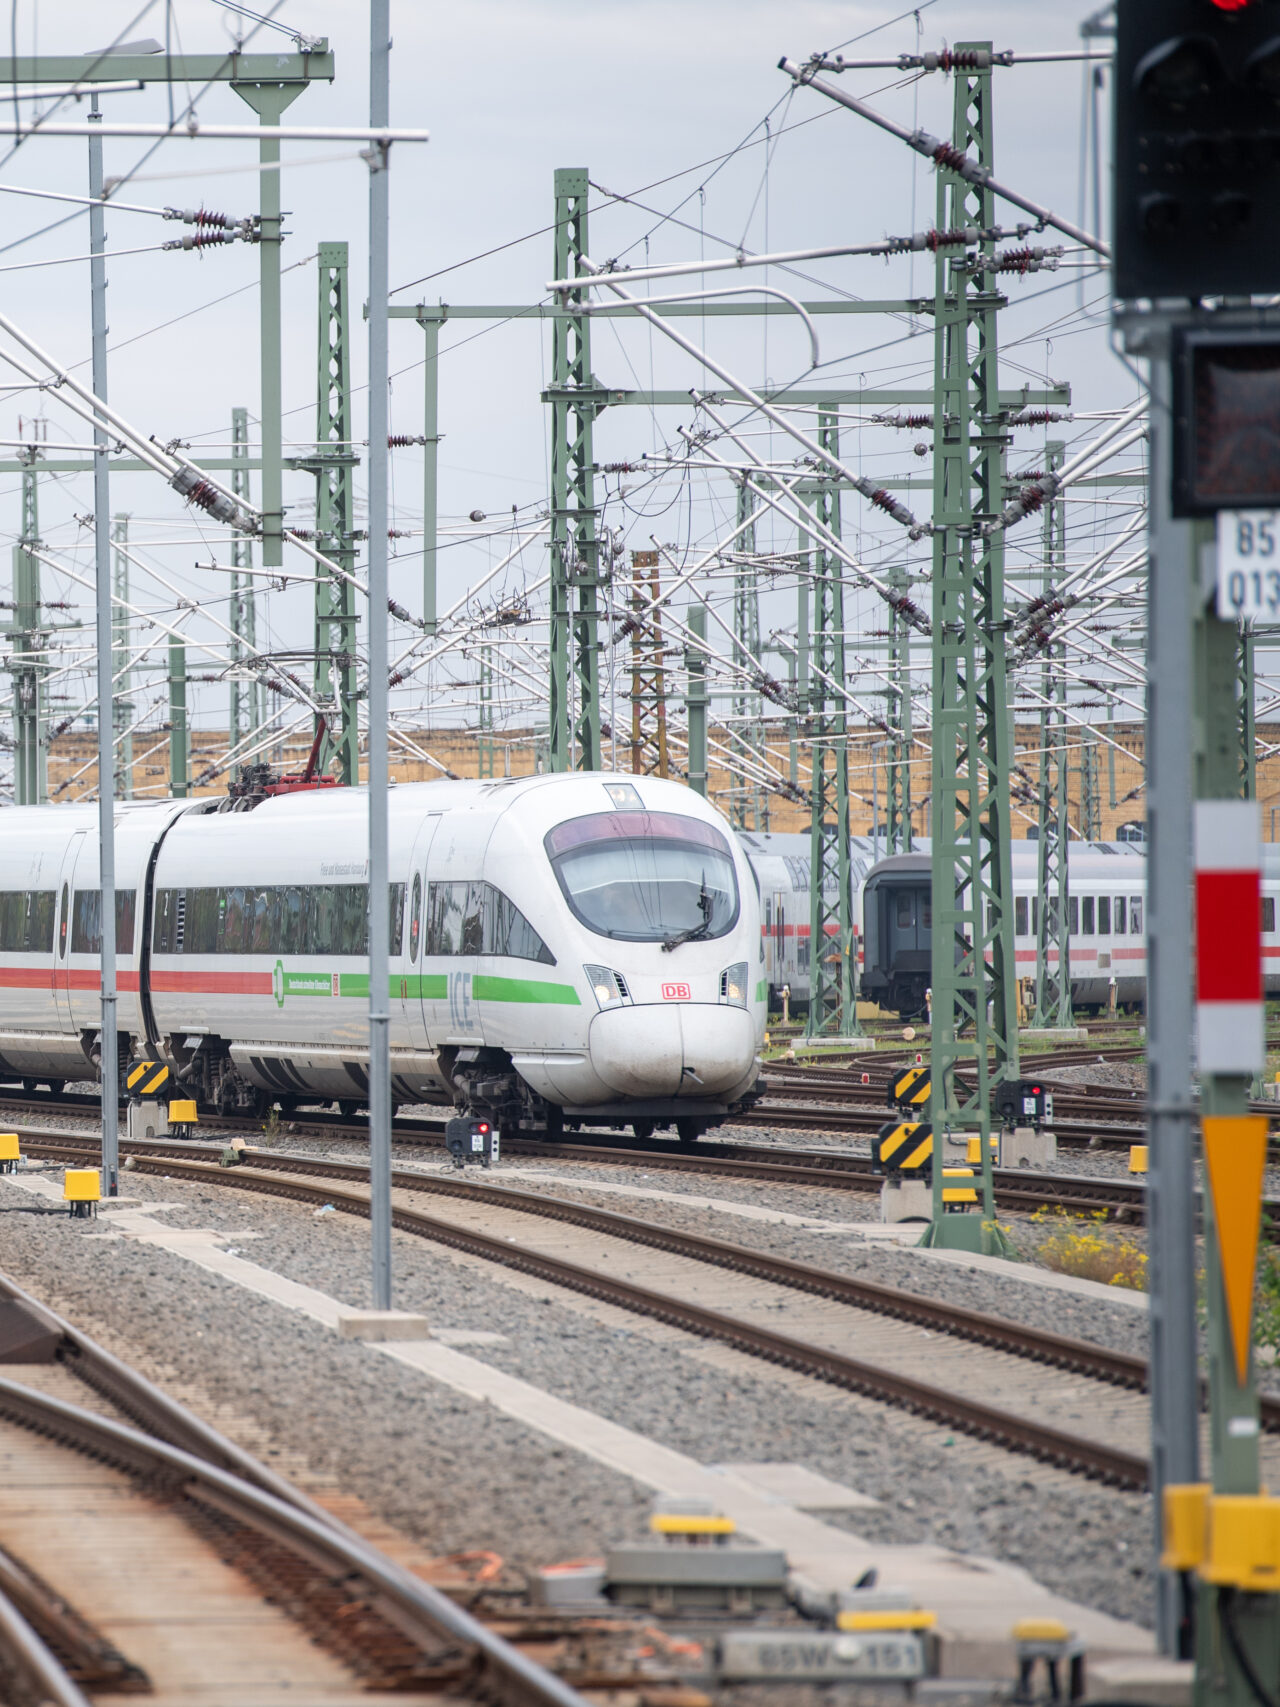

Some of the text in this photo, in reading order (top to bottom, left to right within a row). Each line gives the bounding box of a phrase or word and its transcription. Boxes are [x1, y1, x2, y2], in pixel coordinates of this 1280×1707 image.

[1237, 520, 1275, 556] 85
[450, 971, 474, 1031] ICE
[665, 985, 687, 997] DB
